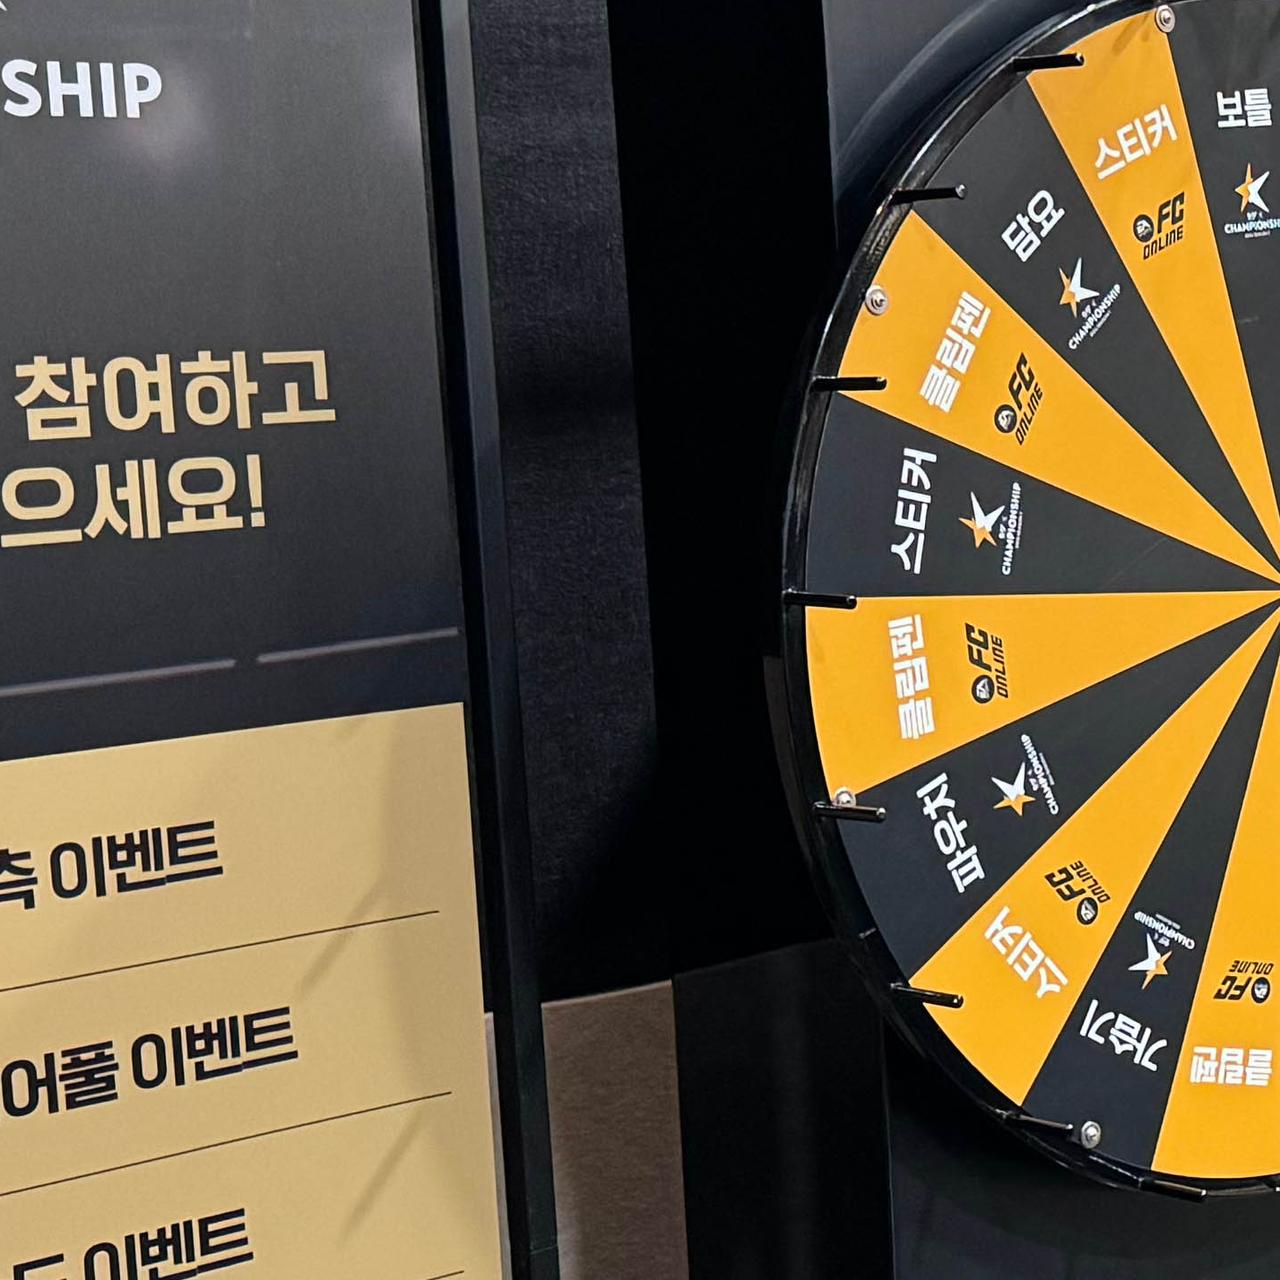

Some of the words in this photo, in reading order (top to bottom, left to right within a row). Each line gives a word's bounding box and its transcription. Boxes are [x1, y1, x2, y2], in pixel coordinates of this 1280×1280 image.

[3, 59, 163, 119] SHIP
[1216, 88, 1273, 128] 보틀
[1094, 104, 1178, 180] 스티커
[1001, 189, 1065, 263] 담요
[1157, 191, 1185, 234] FC
[918, 291, 991, 414] 클립펜
[1008, 352, 1036, 409] FC
[14, 349, 336, 441] 참여하고
[0, 453, 267, 548] 으세요!
[890, 447, 937, 575] 스티커
[887, 614, 936, 740] 클립펜
[964, 623, 993, 673] FC
[49, 820, 224, 899] 이벤트
[916, 772, 986, 893] 파우치
[1044, 866, 1086, 902] FC
[984, 906, 1069, 998] 스티커
[1213, 979, 1252, 1001] FC
[130, 1006, 299, 1090] 이벤트
[1079, 999, 1167, 1071] 가습기
[1189, 1045, 1273, 1086] 클립펜
